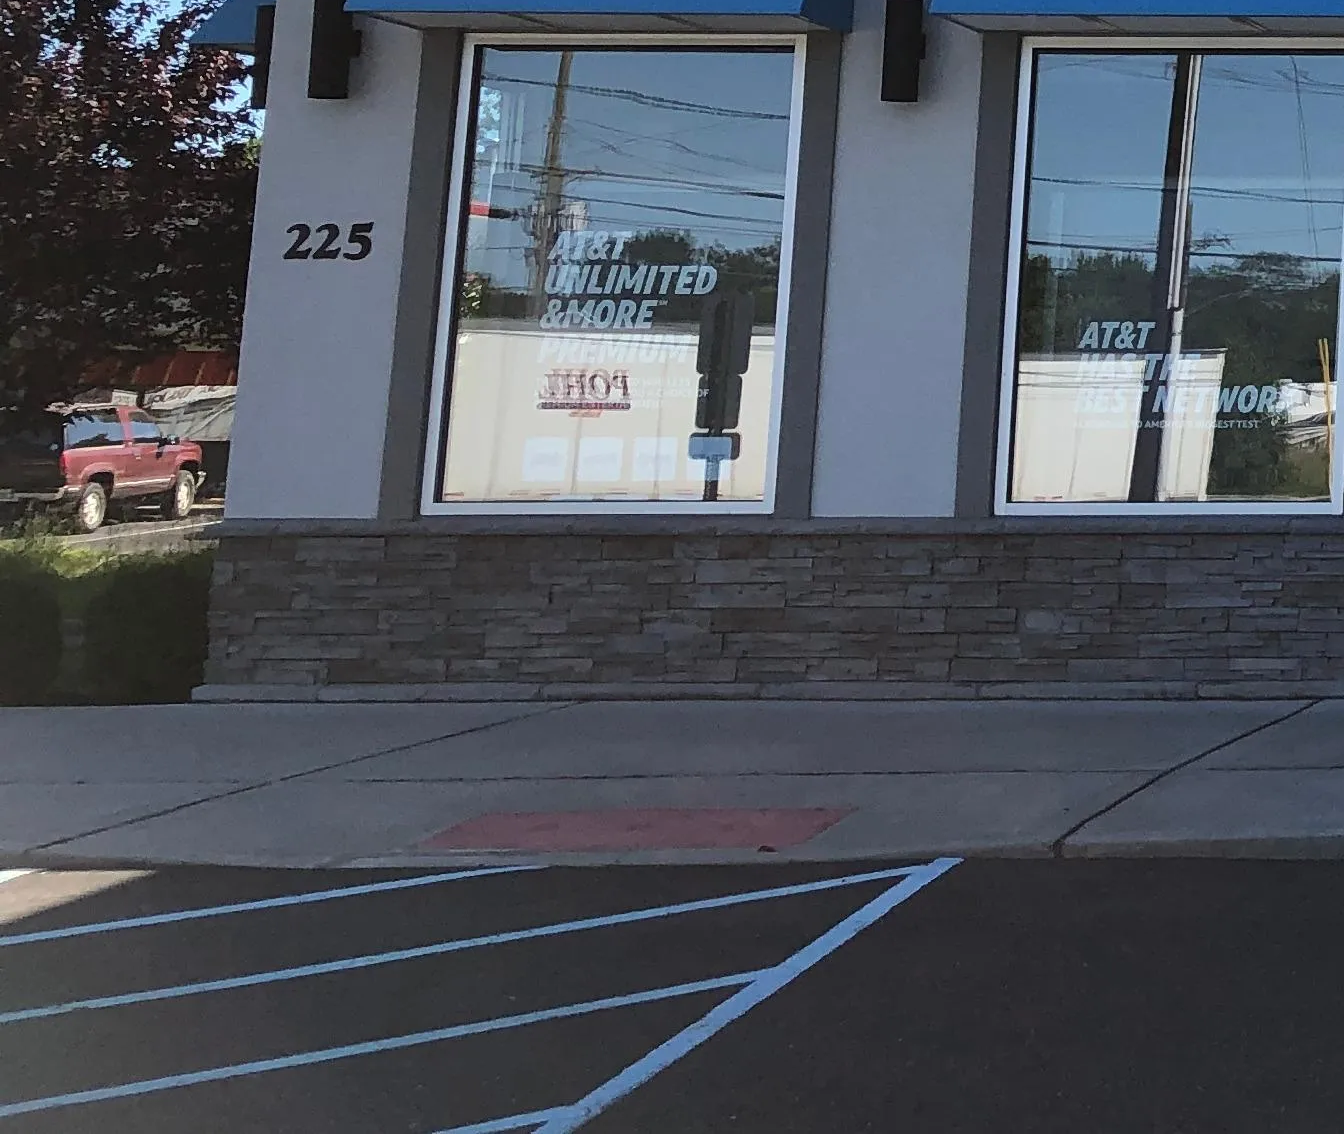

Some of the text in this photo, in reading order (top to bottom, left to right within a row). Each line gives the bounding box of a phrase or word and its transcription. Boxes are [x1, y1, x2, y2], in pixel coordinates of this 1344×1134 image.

[282, 221, 375, 261] 225
[547, 230, 633, 260] AT&T
[544, 264, 719, 295] UNLIMITED
[1077, 320, 1156, 350] AT&T
[1143, 353, 1201, 381] THE
[1236, 420, 1259, 429] TEST
